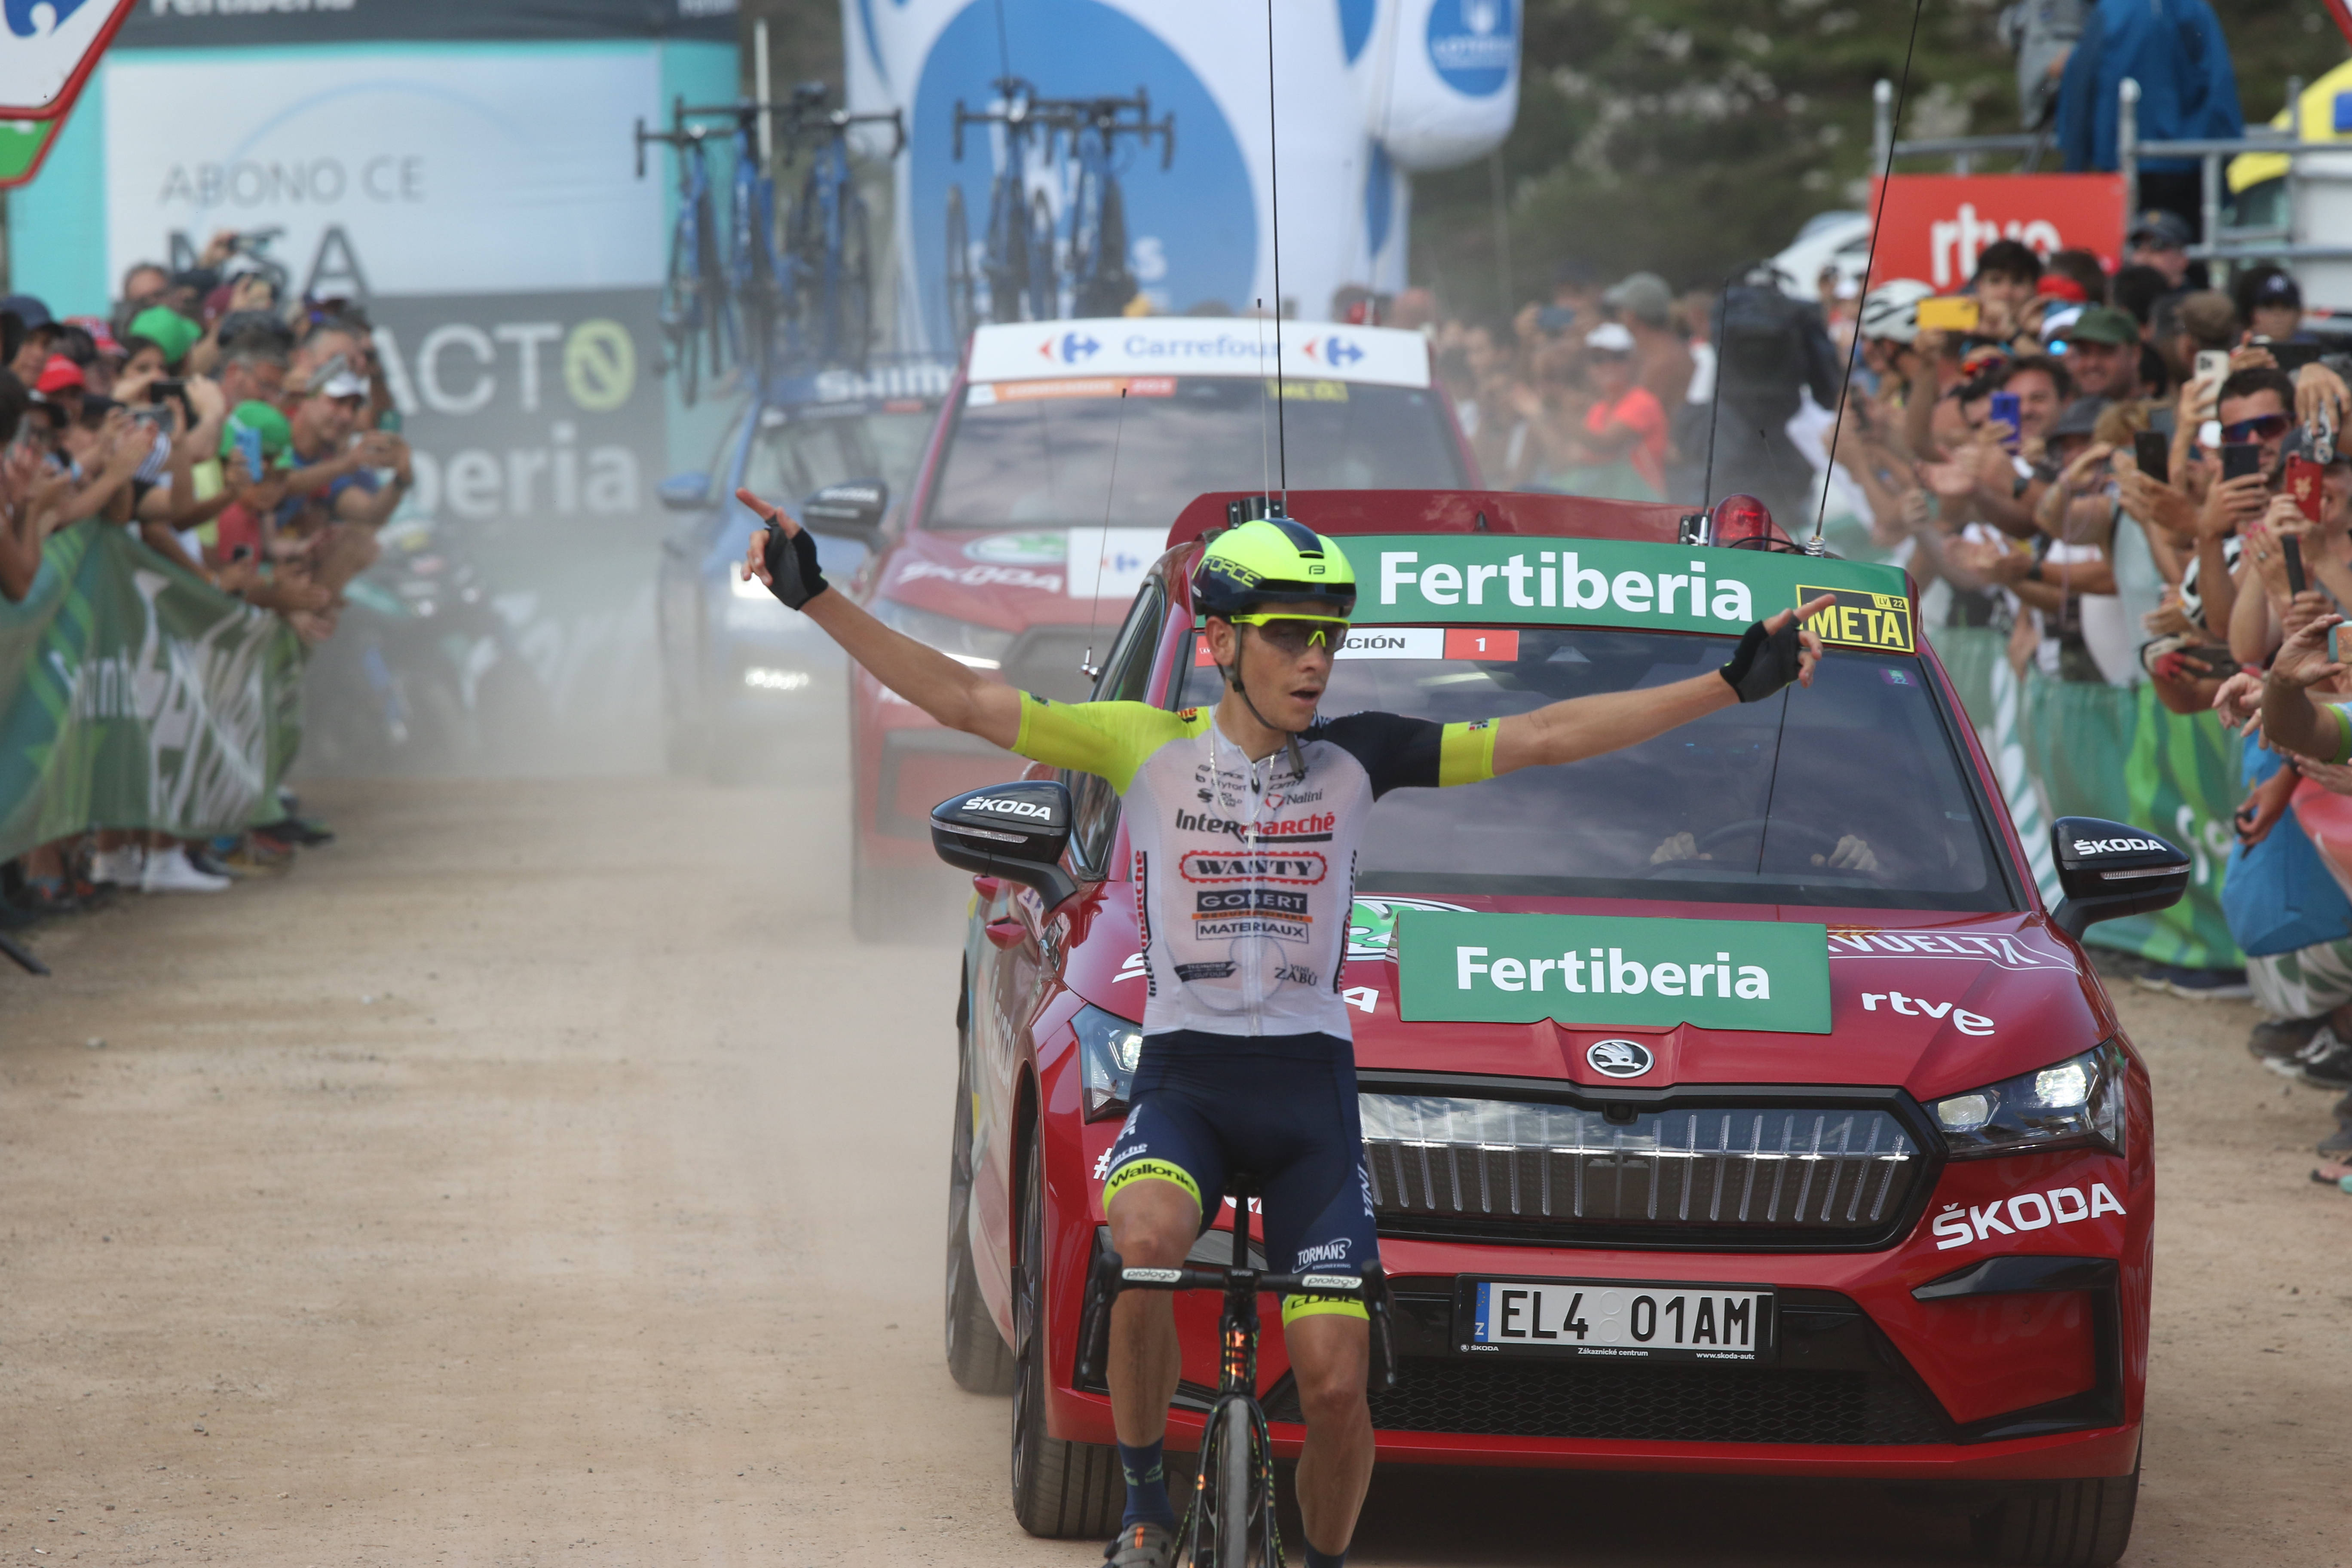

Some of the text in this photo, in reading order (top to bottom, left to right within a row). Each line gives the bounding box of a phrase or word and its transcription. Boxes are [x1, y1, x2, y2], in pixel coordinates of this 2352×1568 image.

[158, 155, 424, 208] ABONO CE
[1124, 334, 1284, 359] Carrefour
[1381, 551, 1753, 622] Fertiberia
[1893, 599, 1903, 608] 22
[1807, 606, 1905, 646] META
[1343, 634, 1406, 649] CIÓN
[1475, 637, 1486, 652] 1
[1286, 788, 1323, 805] Nalini
[962, 796, 1051, 821] ŠKODA
[2073, 838, 2167, 855] ŠKODA
[1196, 860, 1313, 876] WANTY
[1201, 894, 1304, 909] GOBERT
[1200, 922, 1304, 937] MATERIAUX
[1457, 946, 1770, 1000] Fertiberia
[1861, 991, 1995, 1036] rtve
[1111, 1164, 1195, 1192] Wallonie
[1933, 1183, 2127, 1250] ŠKODA
[1297, 1243, 1346, 1266] TORMANS
[1127, 1269, 1176, 1280] prologo
[1308, 1277, 1358, 1287] prologo
[1501, 1289, 1750, 1345] EL4 01AM
[1578, 1348, 1617, 1356] Zákaznické
